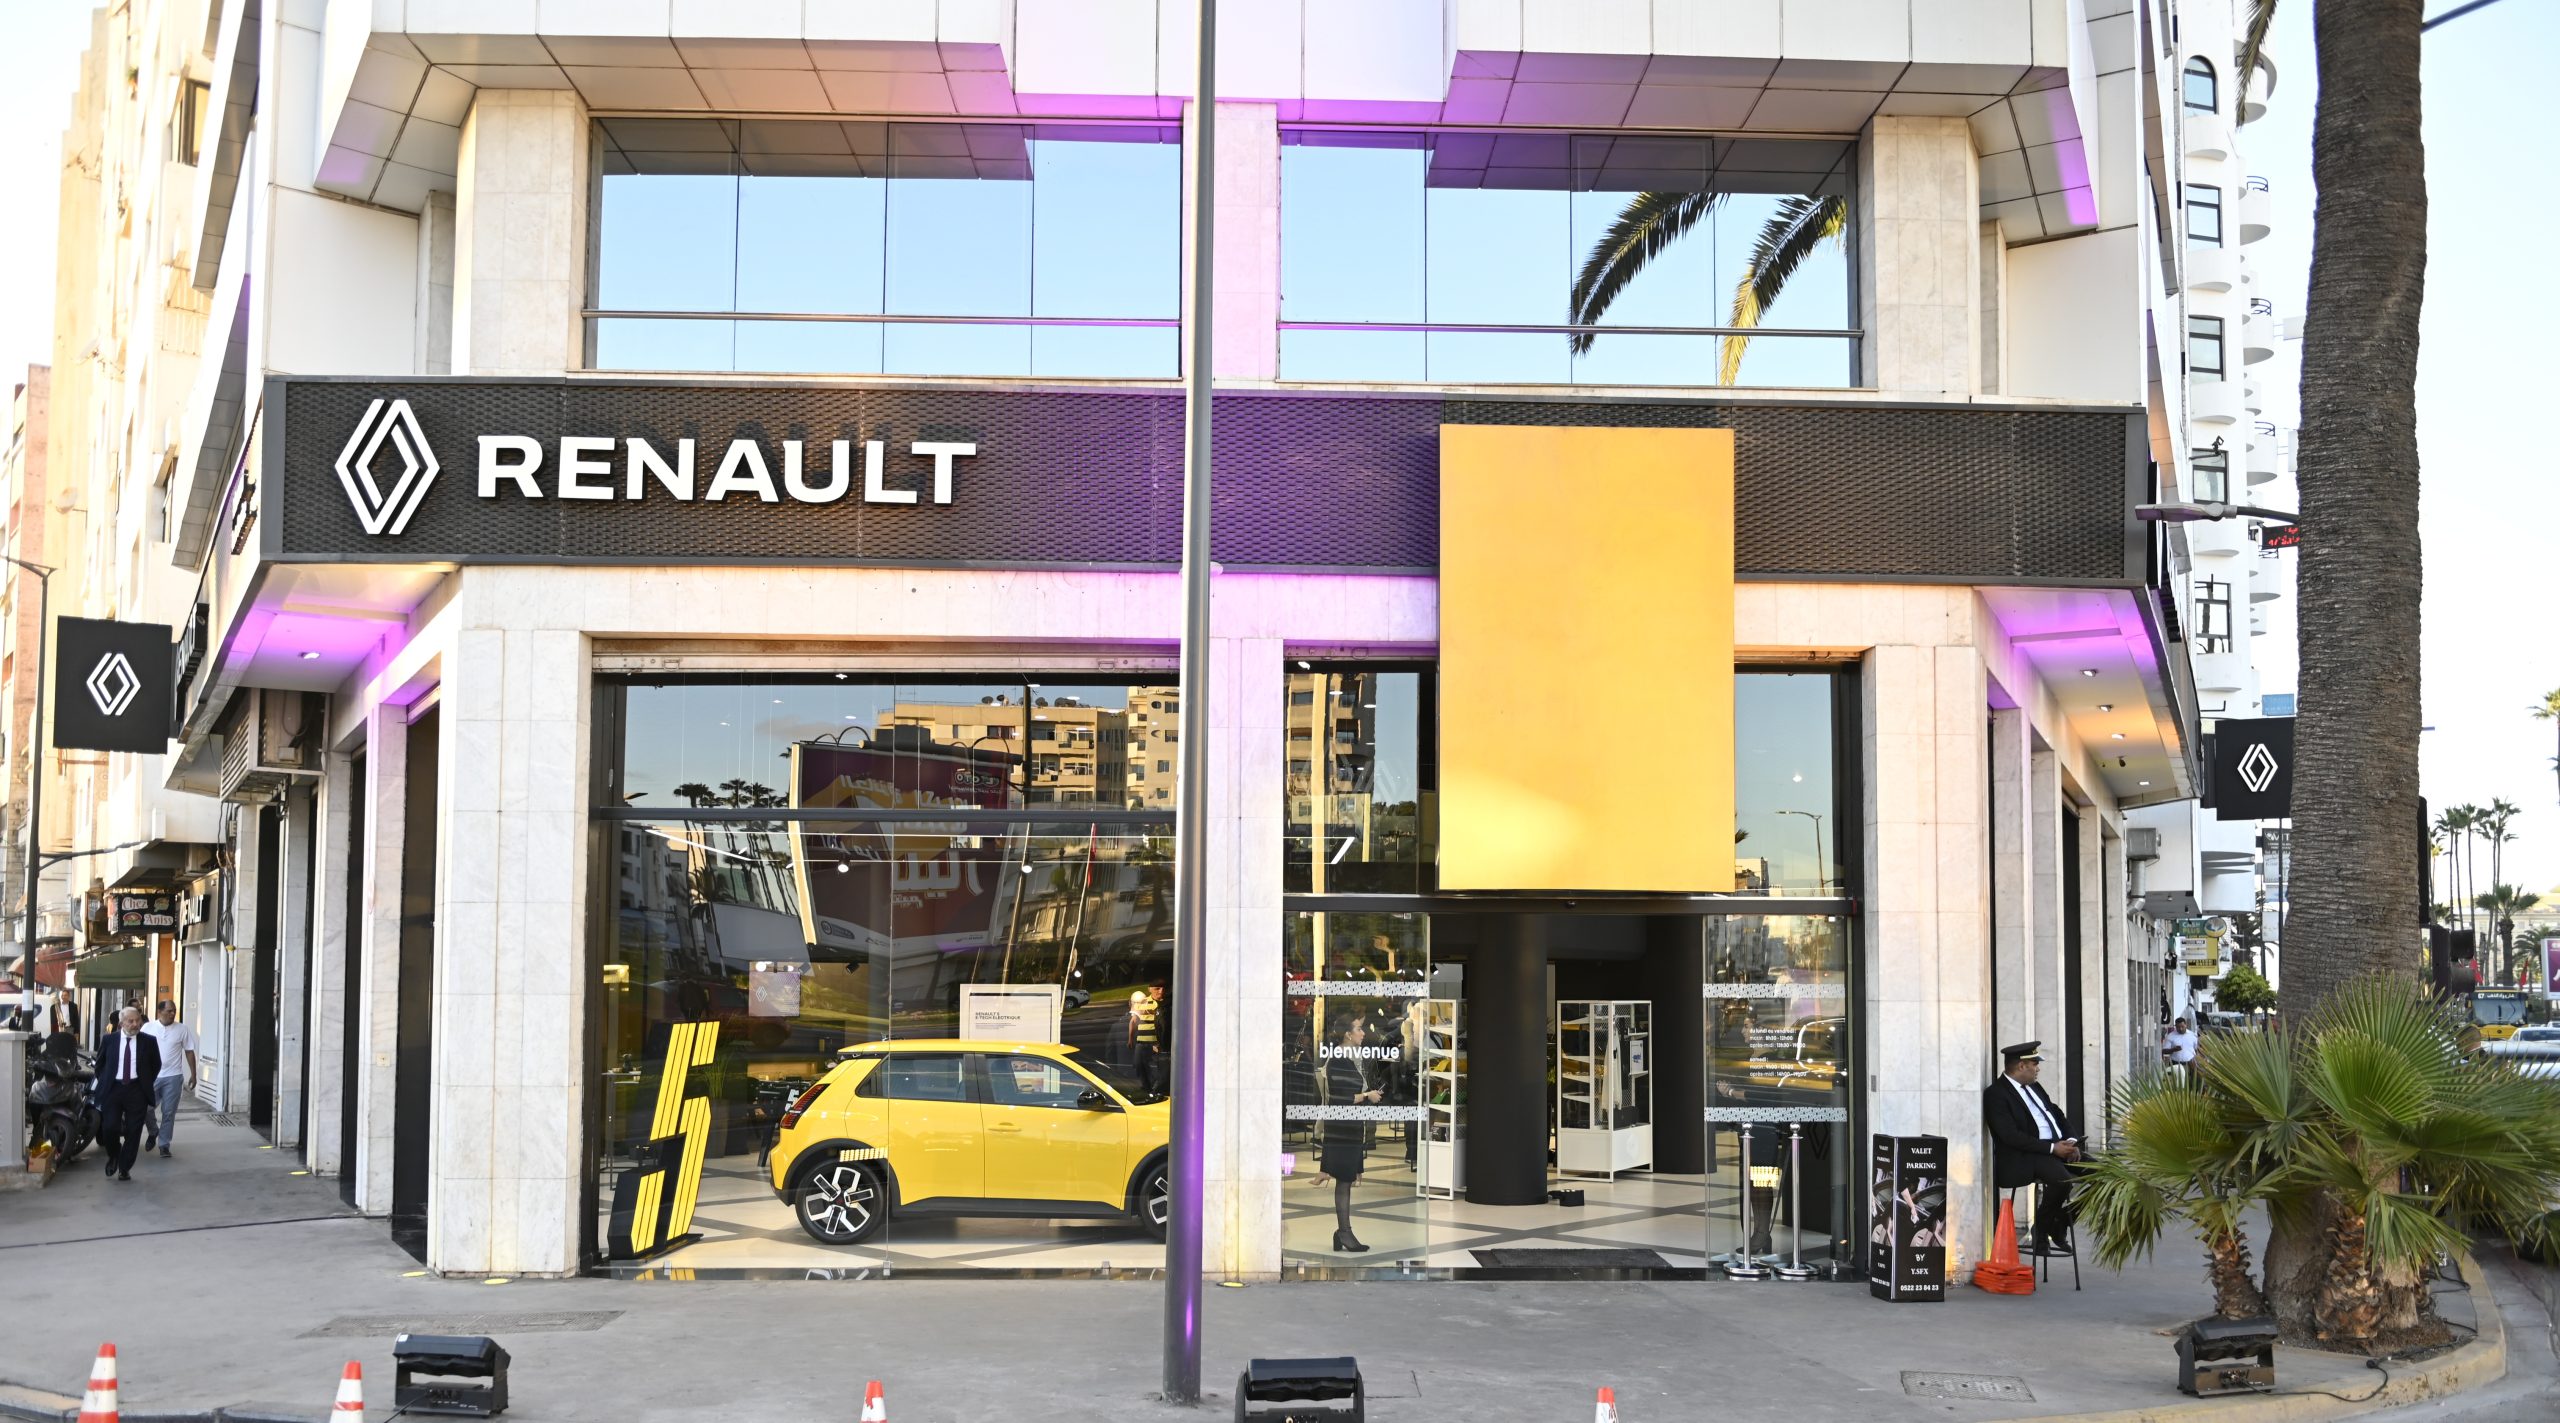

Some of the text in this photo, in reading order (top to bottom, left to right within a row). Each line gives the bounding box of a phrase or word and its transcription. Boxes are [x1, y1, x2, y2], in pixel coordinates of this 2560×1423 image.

[477, 435, 976, 505] RENAULT
[122, 897, 147, 910] Chez
[145, 914, 173, 925] Aniss
[1319, 1042, 1400, 1059] bienvenue
[1911, 1147, 1933, 1155] VALET
[1915, 1253, 1926, 1261] BY
[1910, 1267, 1929, 1275] Y.SFX
